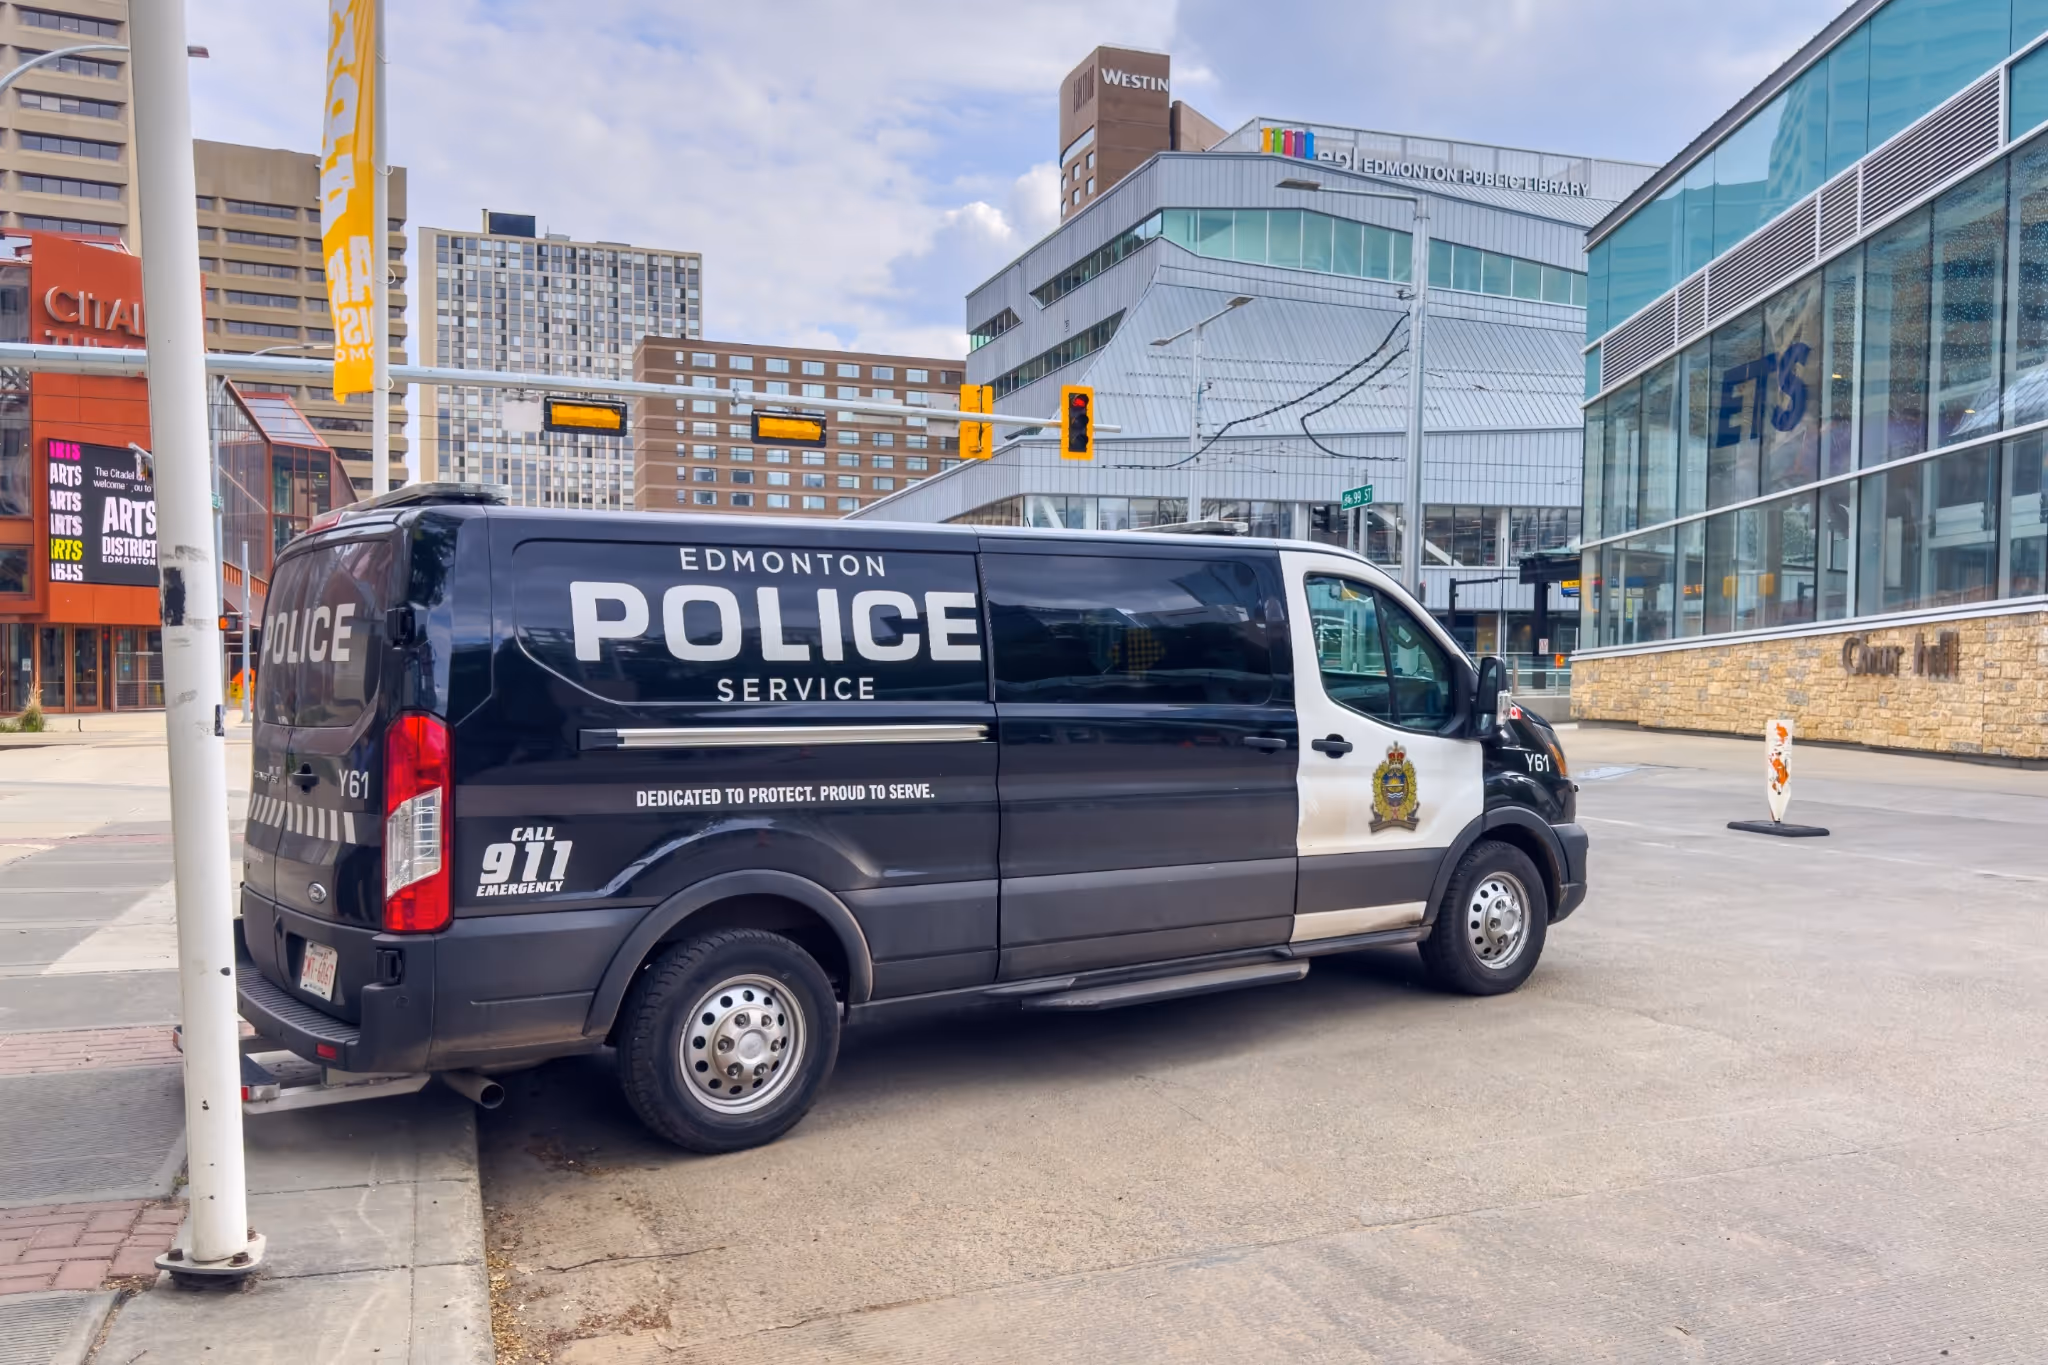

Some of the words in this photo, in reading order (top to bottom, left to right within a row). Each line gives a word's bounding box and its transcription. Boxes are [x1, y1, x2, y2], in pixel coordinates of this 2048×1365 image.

[1101, 67, 1169, 92] WESTIN
[1363, 158, 1457, 182] EDMONTON
[1463, 169, 1520, 189] PUBLIC
[1524, 177, 1589, 197] LIBRARY
[1716, 342, 1810, 448] ETS
[50, 462, 82, 487] ARTS
[94, 466, 109, 478] The
[110, 468, 135, 480] Citadel
[93, 479, 128, 491] welcome
[144, 484, 152, 493] to
[1353, 490, 1361, 504] 99
[1364, 487, 1372, 501] ST
[102, 496, 157, 538] ARTS
[102, 536, 158, 558] DISTRICT
[102, 555, 156, 566] EDMONTON
[679, 547, 885, 577] EDMONTON
[569, 580, 982, 662] POLICE
[262, 603, 356, 666] POLICE
[717, 676, 875, 702] SERVICE
[1524, 753, 1550, 772] Y61
[338, 769, 369, 799] Y61
[636, 788, 721, 807] DEDICATED
[725, 787, 744, 804] TO
[748, 786, 817, 803] PROTECT.
[820, 784, 865, 801] PROUD
[869, 784, 886, 800] TO
[889, 783, 935, 799] SERVE.
[511, 826, 555, 842] CALL
[480, 840, 573, 884] 911
[476, 881, 564, 897] EMERGENCY
